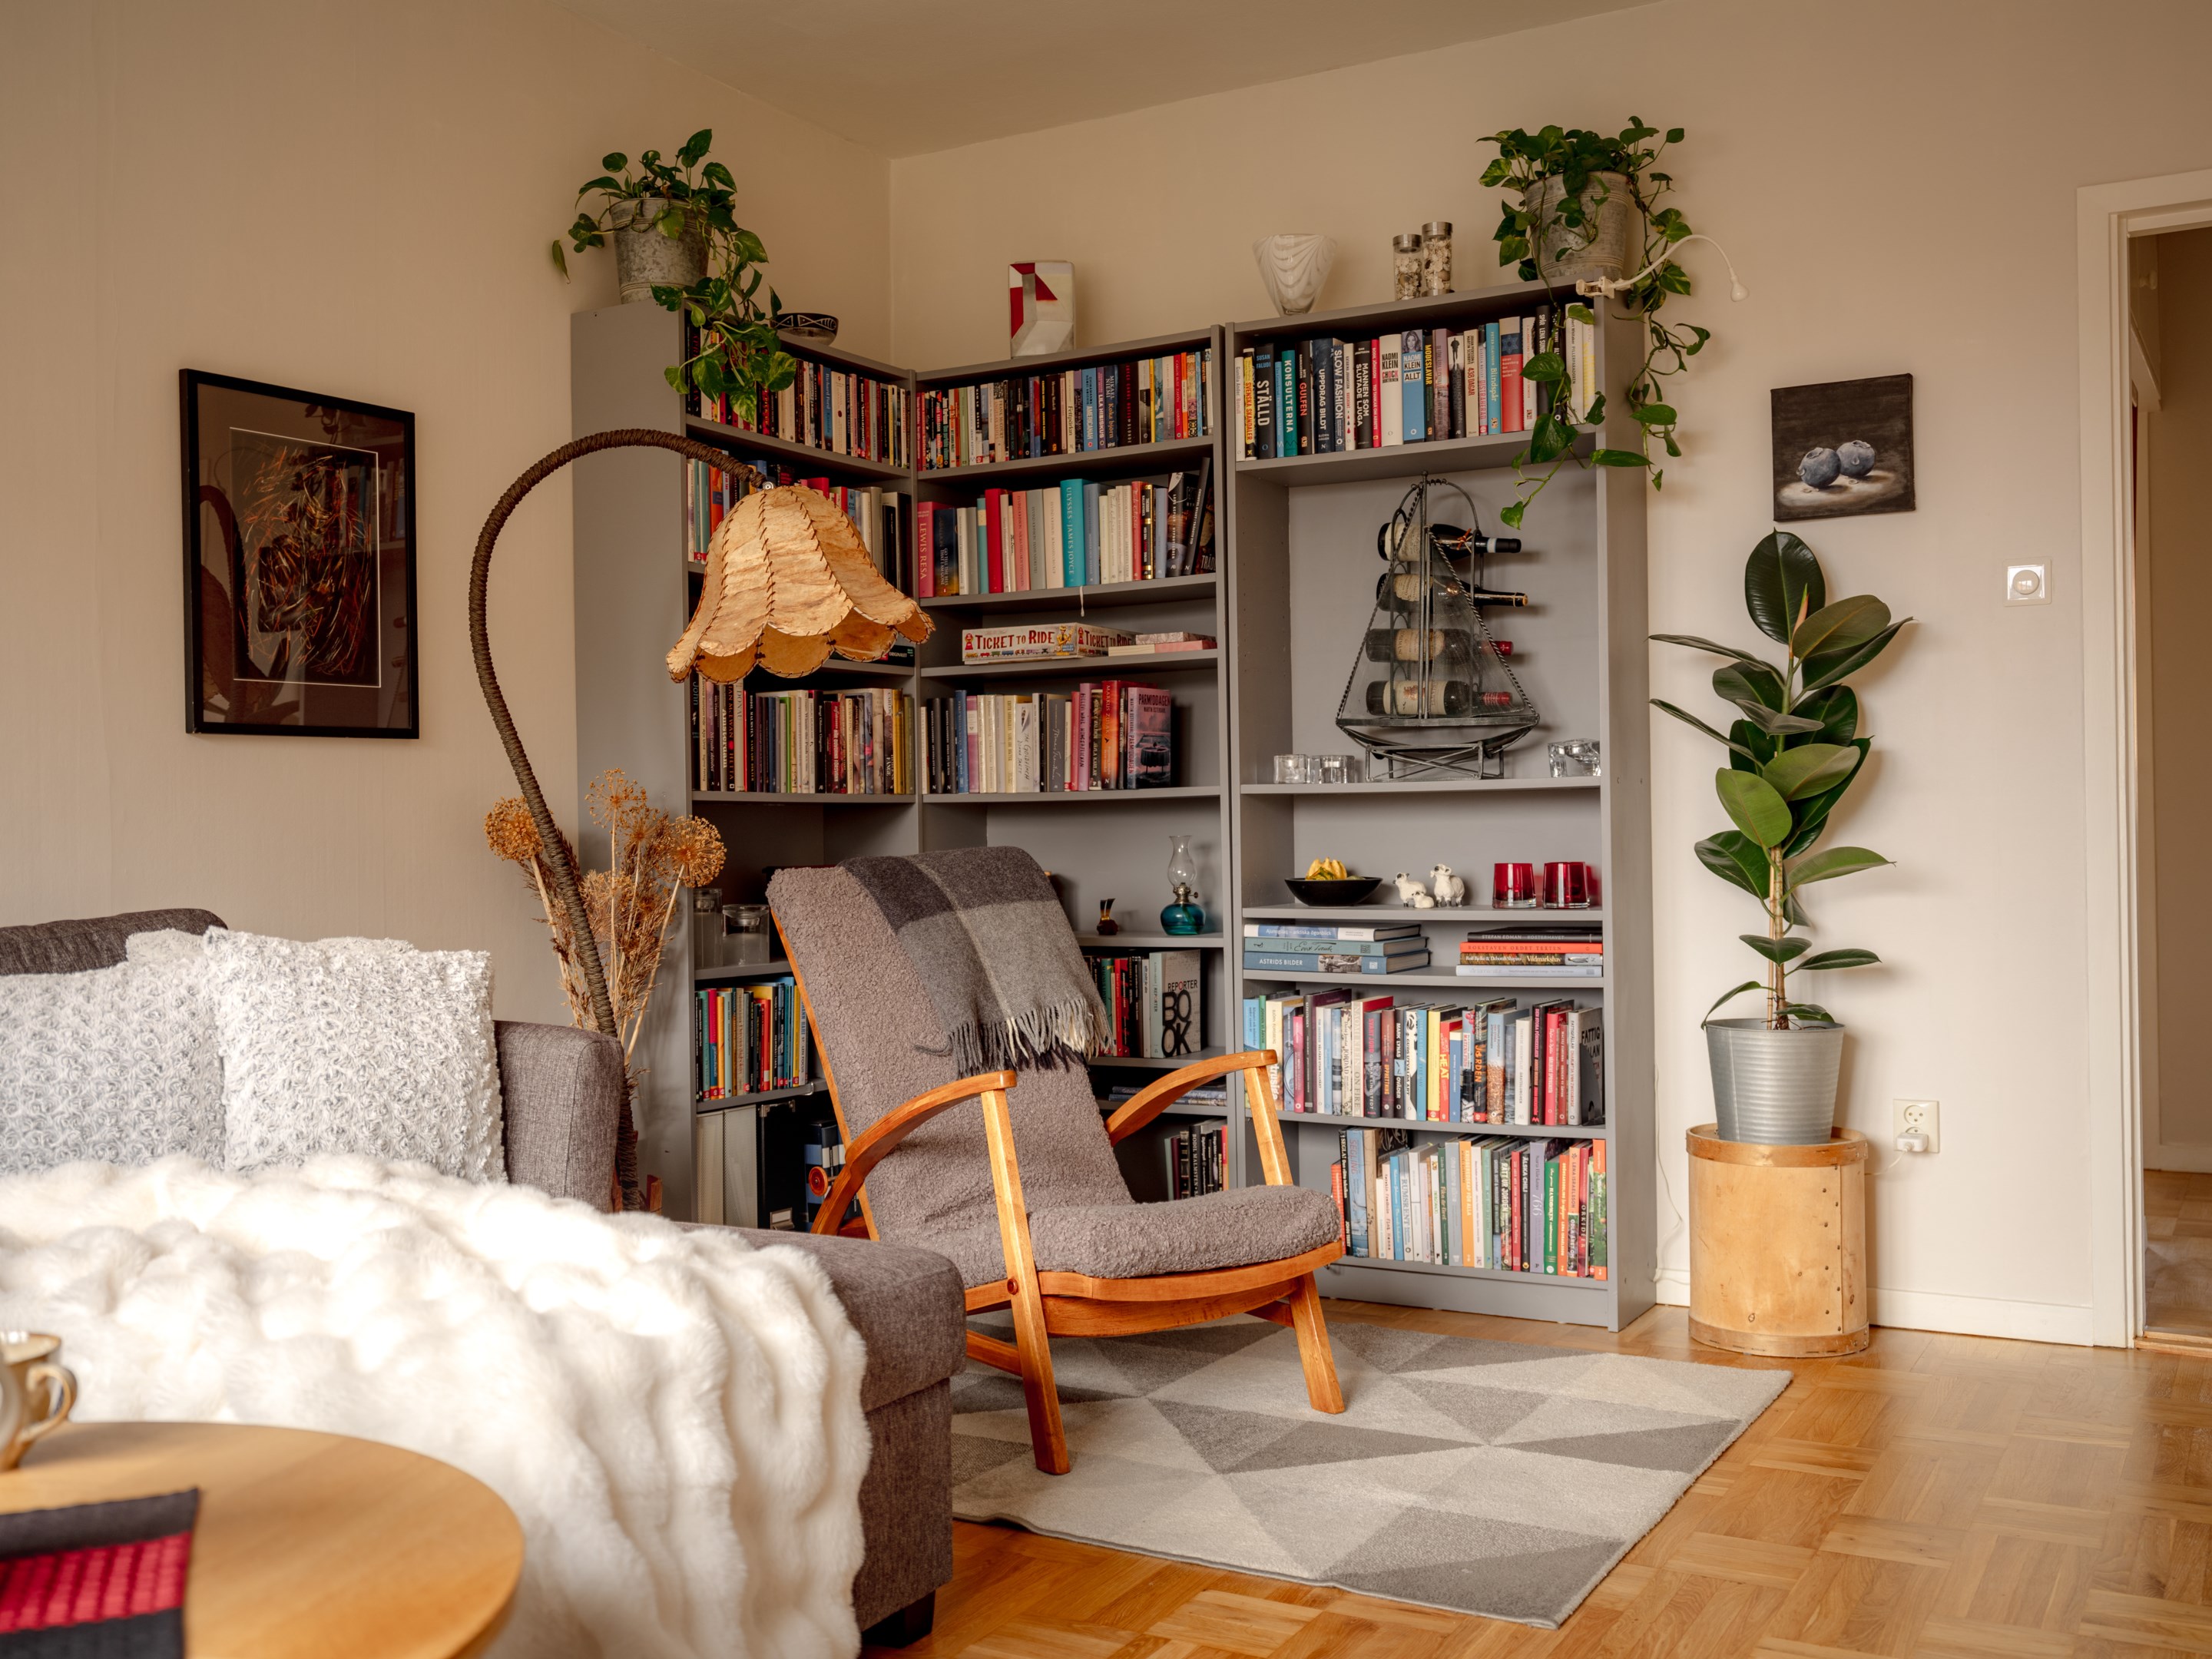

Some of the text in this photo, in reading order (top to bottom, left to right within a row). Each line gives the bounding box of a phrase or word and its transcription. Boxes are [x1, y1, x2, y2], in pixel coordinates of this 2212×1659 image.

[1334, 349, 1343, 376] SLOW
[1382, 353, 1399, 361] NAOMI
[1382, 359, 1399, 370] KLEIN
[1404, 361, 1421, 370] KLEIN
[1382, 370, 1399, 379] CHOCK
[1405, 373, 1421, 382] ALLT
[1489, 368, 1498, 402] Blindspår
[1257, 380, 1272, 426] STÄLLD
[1284, 359, 1293, 433] KONSULTERNA
[1335, 379, 1343, 419] FASHION
[940, 564, 945, 572] AM
[975, 630, 1055, 650] TICKET TO RIDE
[1084, 630, 1109, 647] TICKET
[1138, 694, 1171, 706] PARMIDDAGEN
[1023, 744, 1031, 780] GOLDFINCH
[1167, 979, 1198, 992] REPORTER
[1581, 1026, 1601, 1045] FATTIG
[1439, 1054, 1449, 1079] HEAT
[1354, 1071, 1361, 1086] ON
[1349, 1139, 1359, 1174] SEGLING
[1501, 1162, 1509, 1178] RÄTT
[1502, 1179, 1508, 1187] UR
[1532, 1193, 1543, 1216] 766
[1570, 1250, 1575, 1259] OM
